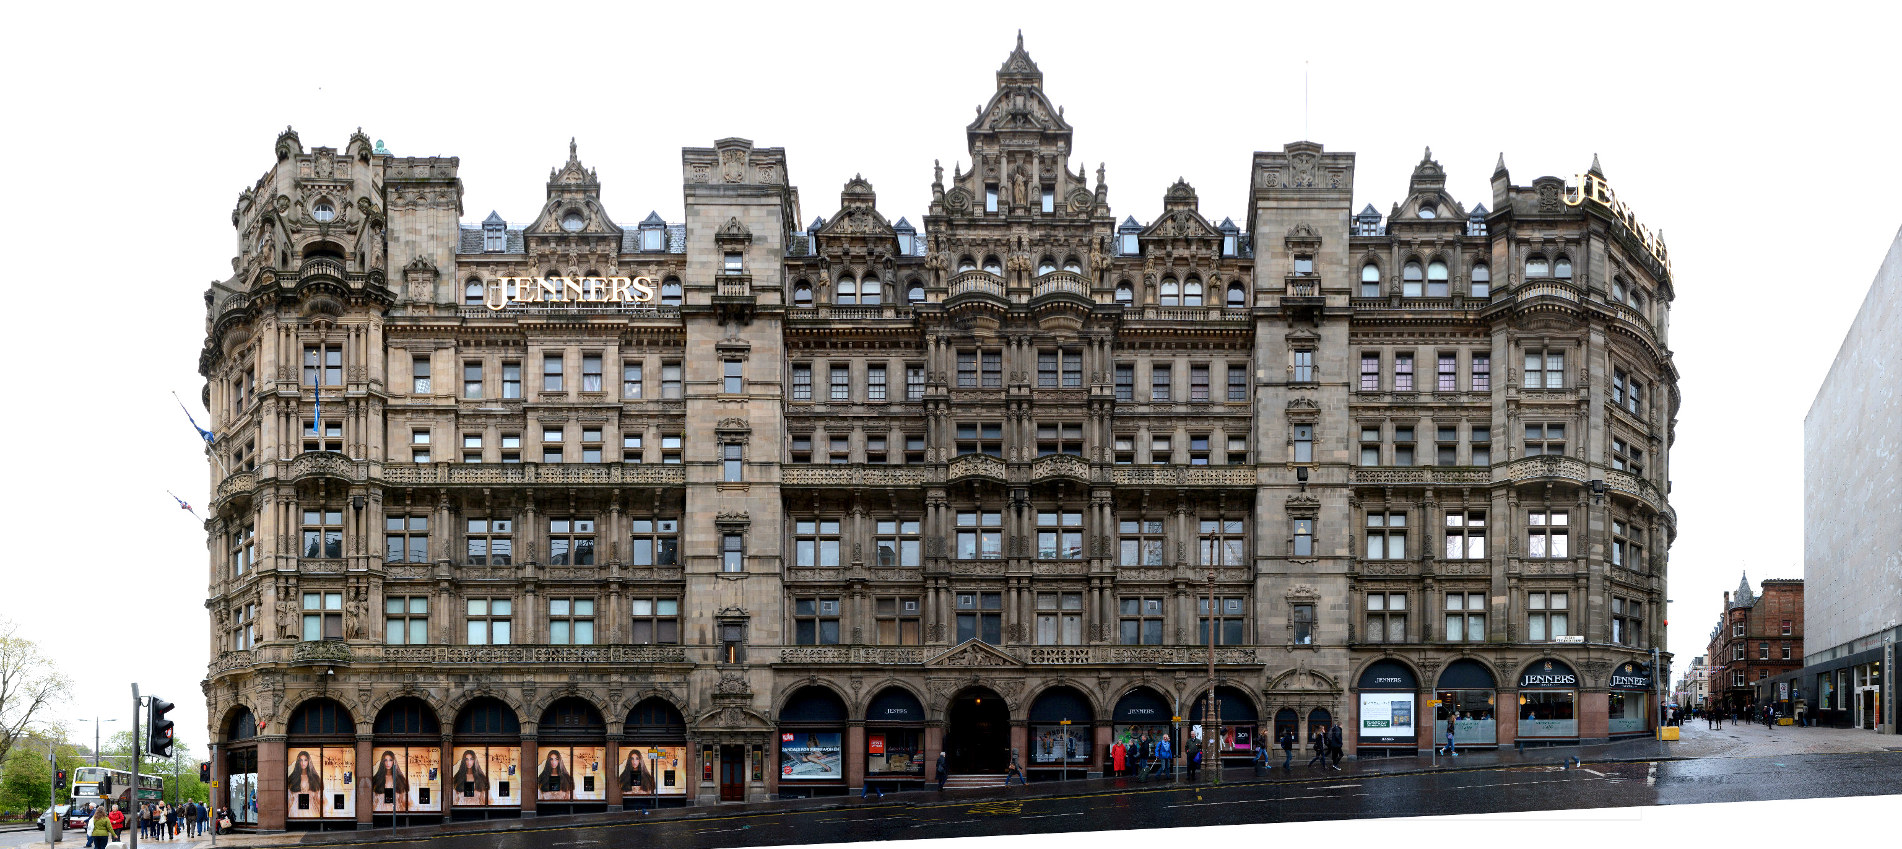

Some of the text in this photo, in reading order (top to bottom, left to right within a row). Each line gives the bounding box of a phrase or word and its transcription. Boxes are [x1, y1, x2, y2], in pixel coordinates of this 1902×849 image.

[1563, 174, 1675, 286] JENNE
[487, 276, 654, 310] JENNERS
[1520, 674, 1575, 686] JENNERS
[1609, 675, 1647, 687] JENNE
